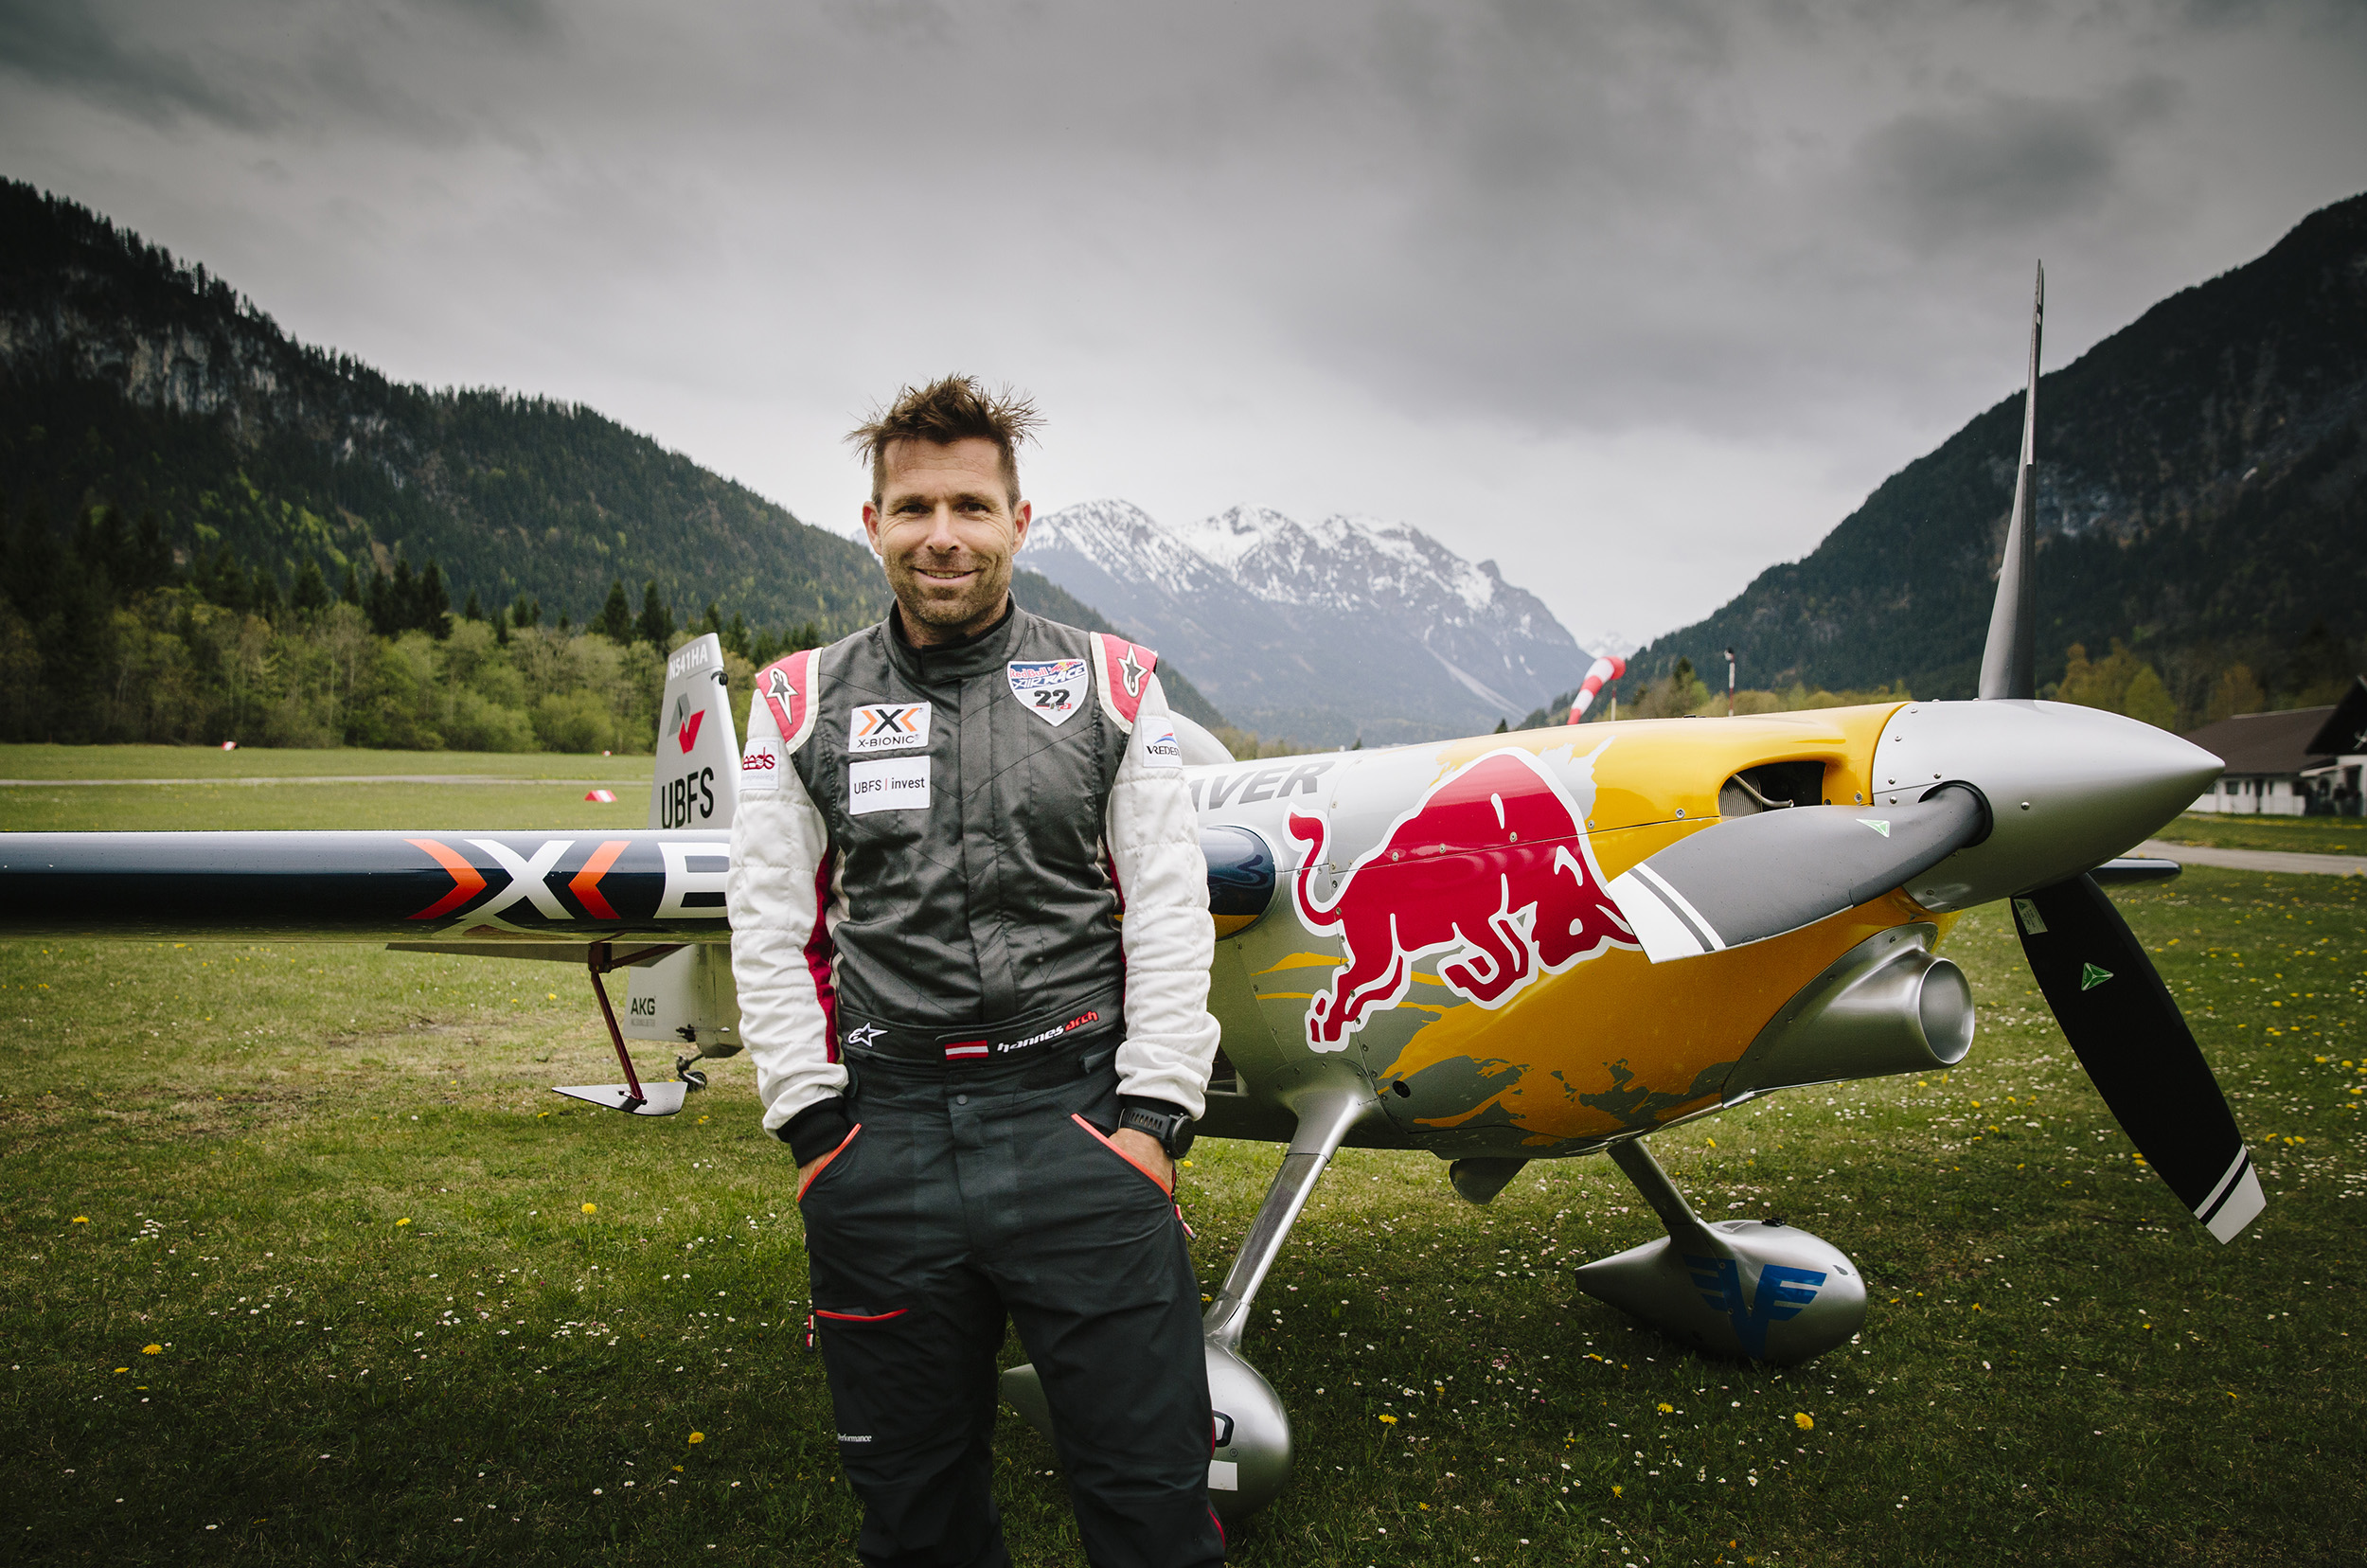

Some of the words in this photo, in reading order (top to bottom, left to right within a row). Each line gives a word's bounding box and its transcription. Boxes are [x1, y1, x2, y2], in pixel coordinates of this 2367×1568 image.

[668, 643, 708, 681] N541HA
[1009, 668, 1027, 678] Red
[1028, 666, 1048, 678] Bull
[1043, 666, 1086, 685] RACE
[1034, 688, 1070, 706] 22
[854, 779, 881, 795] UBFS
[891, 777, 925, 790] invest
[662, 766, 714, 829] UBFS
[631, 997, 655, 1015] AKG
